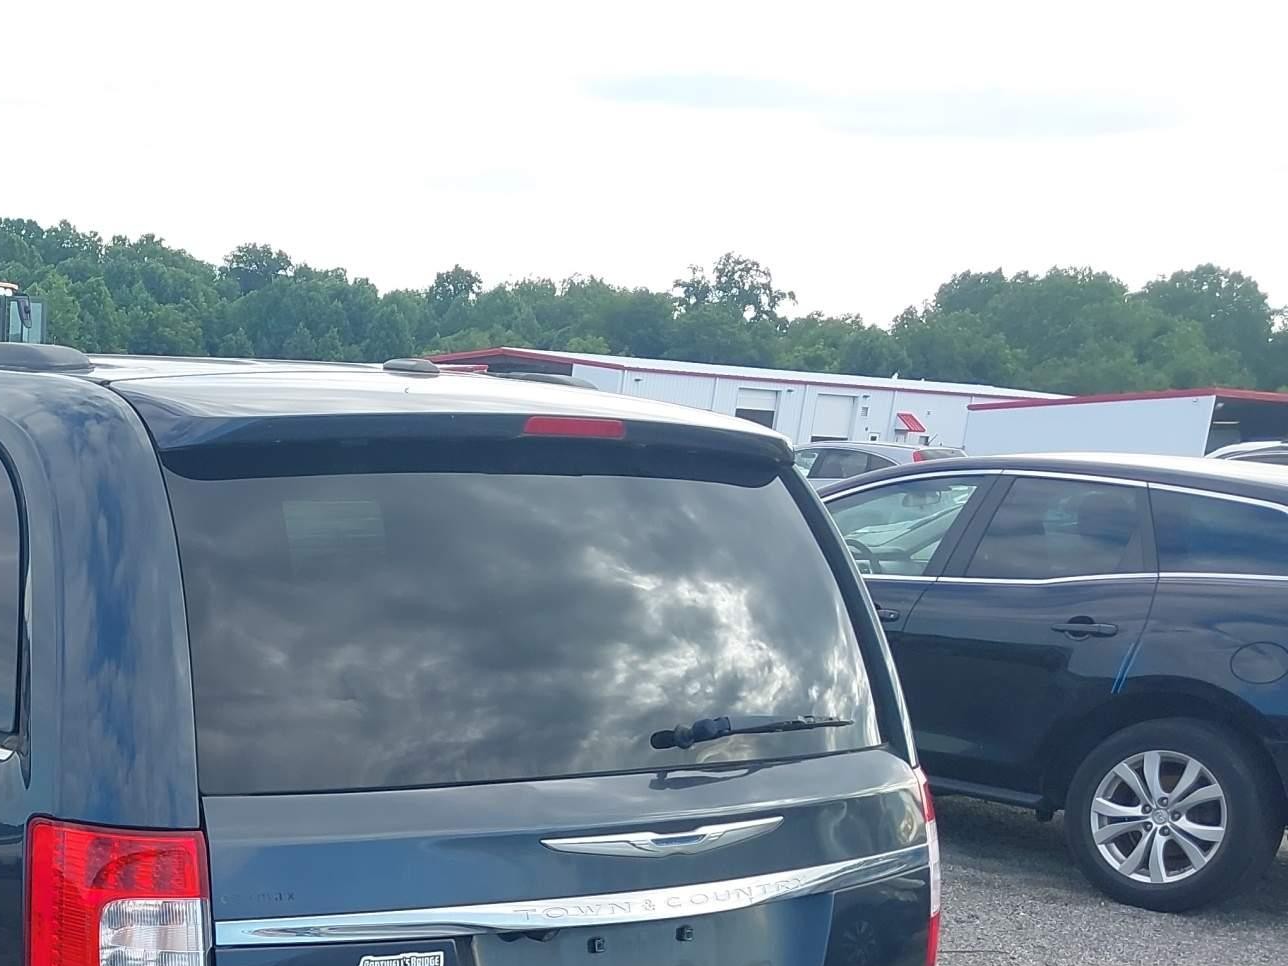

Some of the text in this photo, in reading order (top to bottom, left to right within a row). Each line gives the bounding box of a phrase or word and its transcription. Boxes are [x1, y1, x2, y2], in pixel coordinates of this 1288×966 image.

[513, 874, 807, 921] TOWN & COUNTRY
